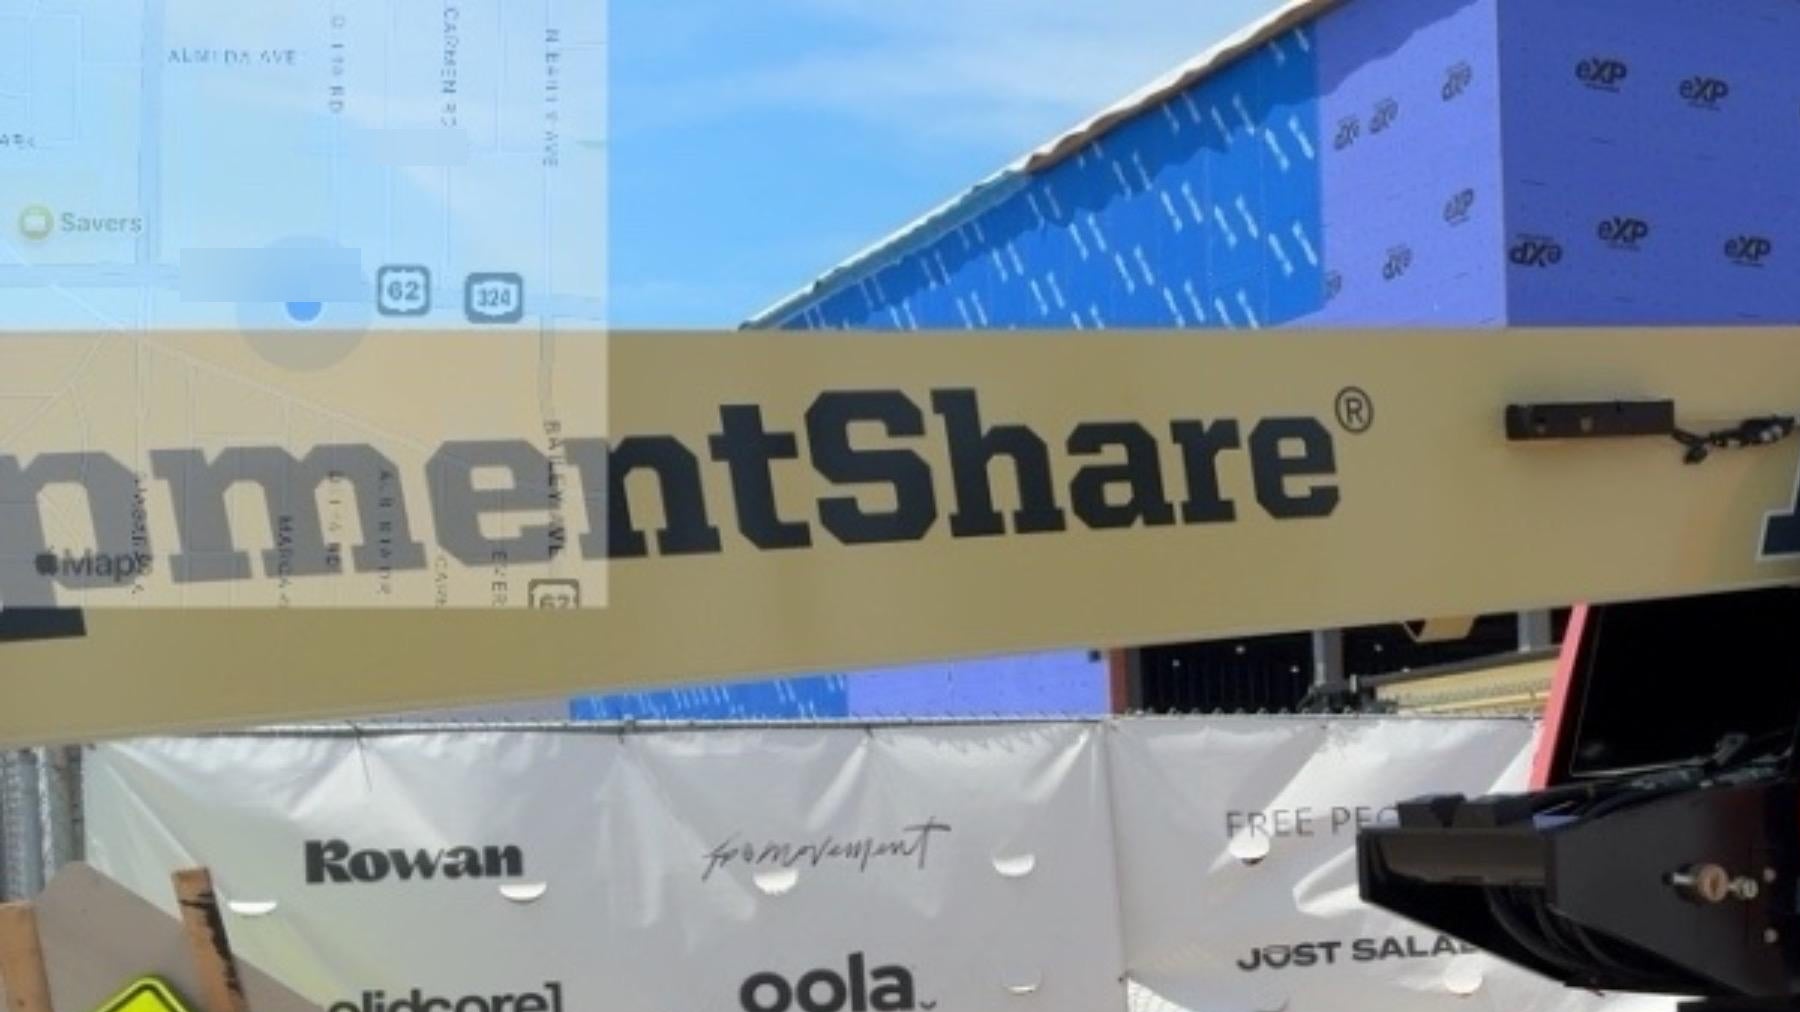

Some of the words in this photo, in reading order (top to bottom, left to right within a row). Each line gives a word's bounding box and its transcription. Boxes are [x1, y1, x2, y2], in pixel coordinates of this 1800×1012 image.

[1226, 808, 1315, 838] FREE
[305, 838, 524, 884] Rowan
[1237, 942, 1341, 972] JUST
